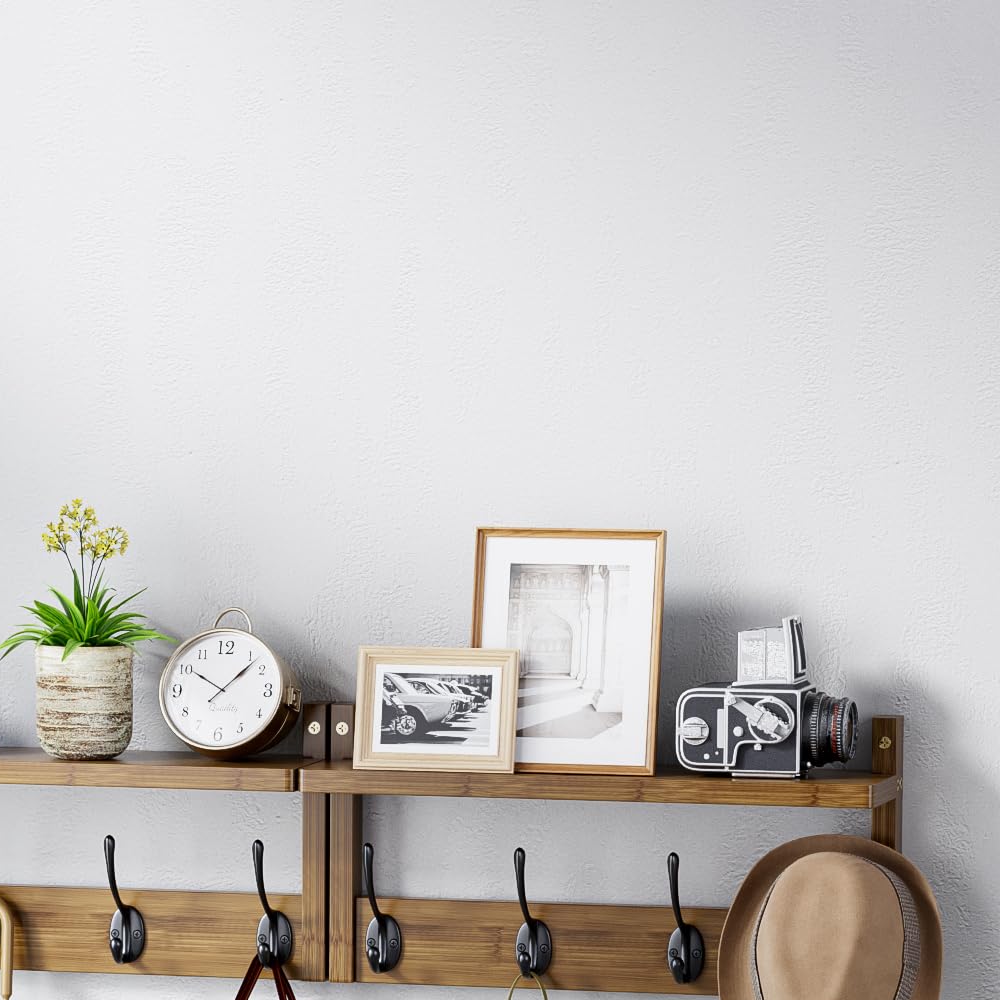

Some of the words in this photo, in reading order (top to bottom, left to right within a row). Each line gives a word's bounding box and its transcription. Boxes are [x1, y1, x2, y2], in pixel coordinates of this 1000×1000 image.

[218, 640, 235, 655] 12
[198, 649, 207, 660] 11
[180, 664, 193, 674] 10
[258, 665, 266, 675] 2
[173, 684, 182, 698] 9
[263, 683, 273, 698] 3
[181, 706, 189, 717] 8
[256, 708, 262, 718] 4
[194, 720, 202, 730] 7
[236, 722, 244, 733] 5
[213, 727, 223, 741] 6
